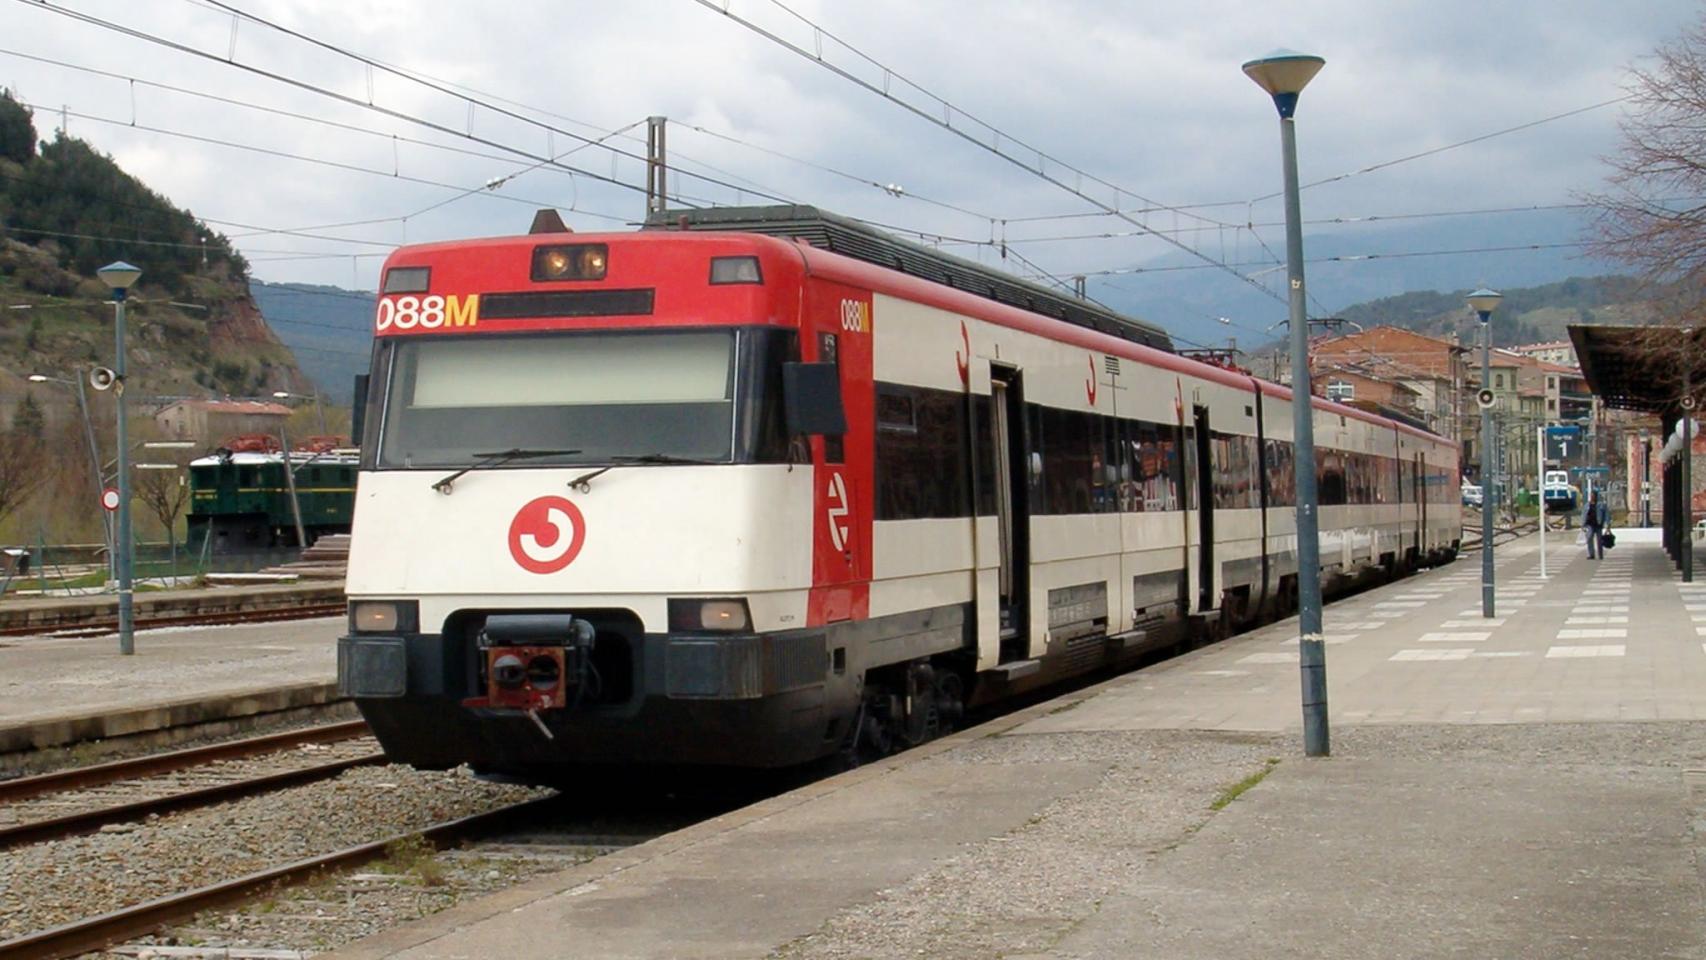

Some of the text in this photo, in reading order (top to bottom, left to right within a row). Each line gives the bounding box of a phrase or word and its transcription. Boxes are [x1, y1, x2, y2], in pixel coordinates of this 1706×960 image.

[376, 294, 479, 331] 088M
[841, 298, 870, 333] 088M
[1558, 441, 1567, 457] 1
